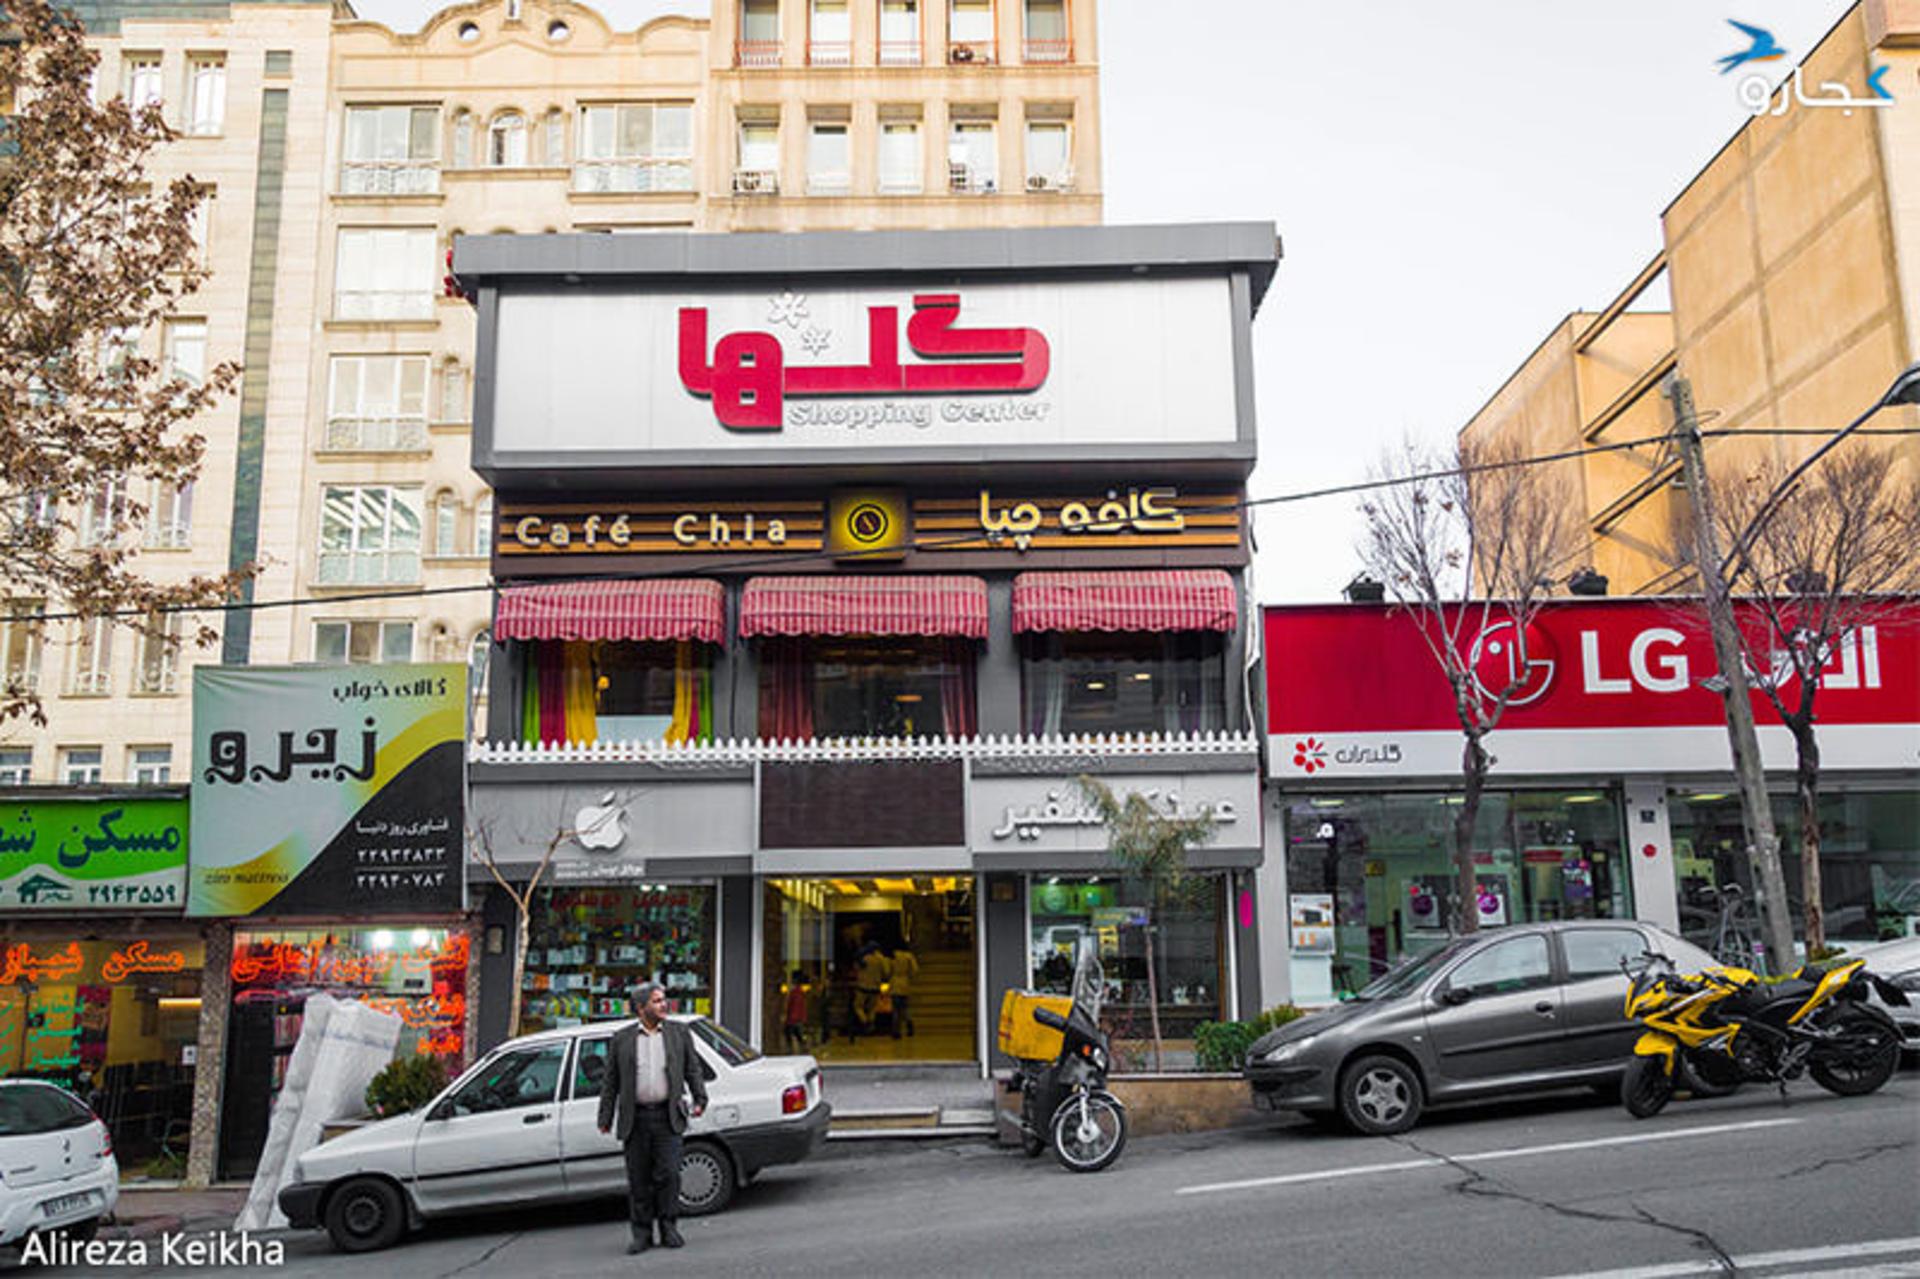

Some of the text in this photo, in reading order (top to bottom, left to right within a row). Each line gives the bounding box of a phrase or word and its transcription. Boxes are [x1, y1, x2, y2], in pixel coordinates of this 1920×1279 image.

[678, 294, 1050, 433] گلها
[788, 399, 1050, 430] Shopping Center
[515, 513, 786, 546] Café Chia
[1060, 487, 1185, 532] کافه
[1580, 627, 1690, 694] LG
[332, 679, 389, 703] خواب
[203, 716, 378, 785] زیرو
[58, 808, 181, 868] مسکن
[102, 940, 185, 983] مسکن
